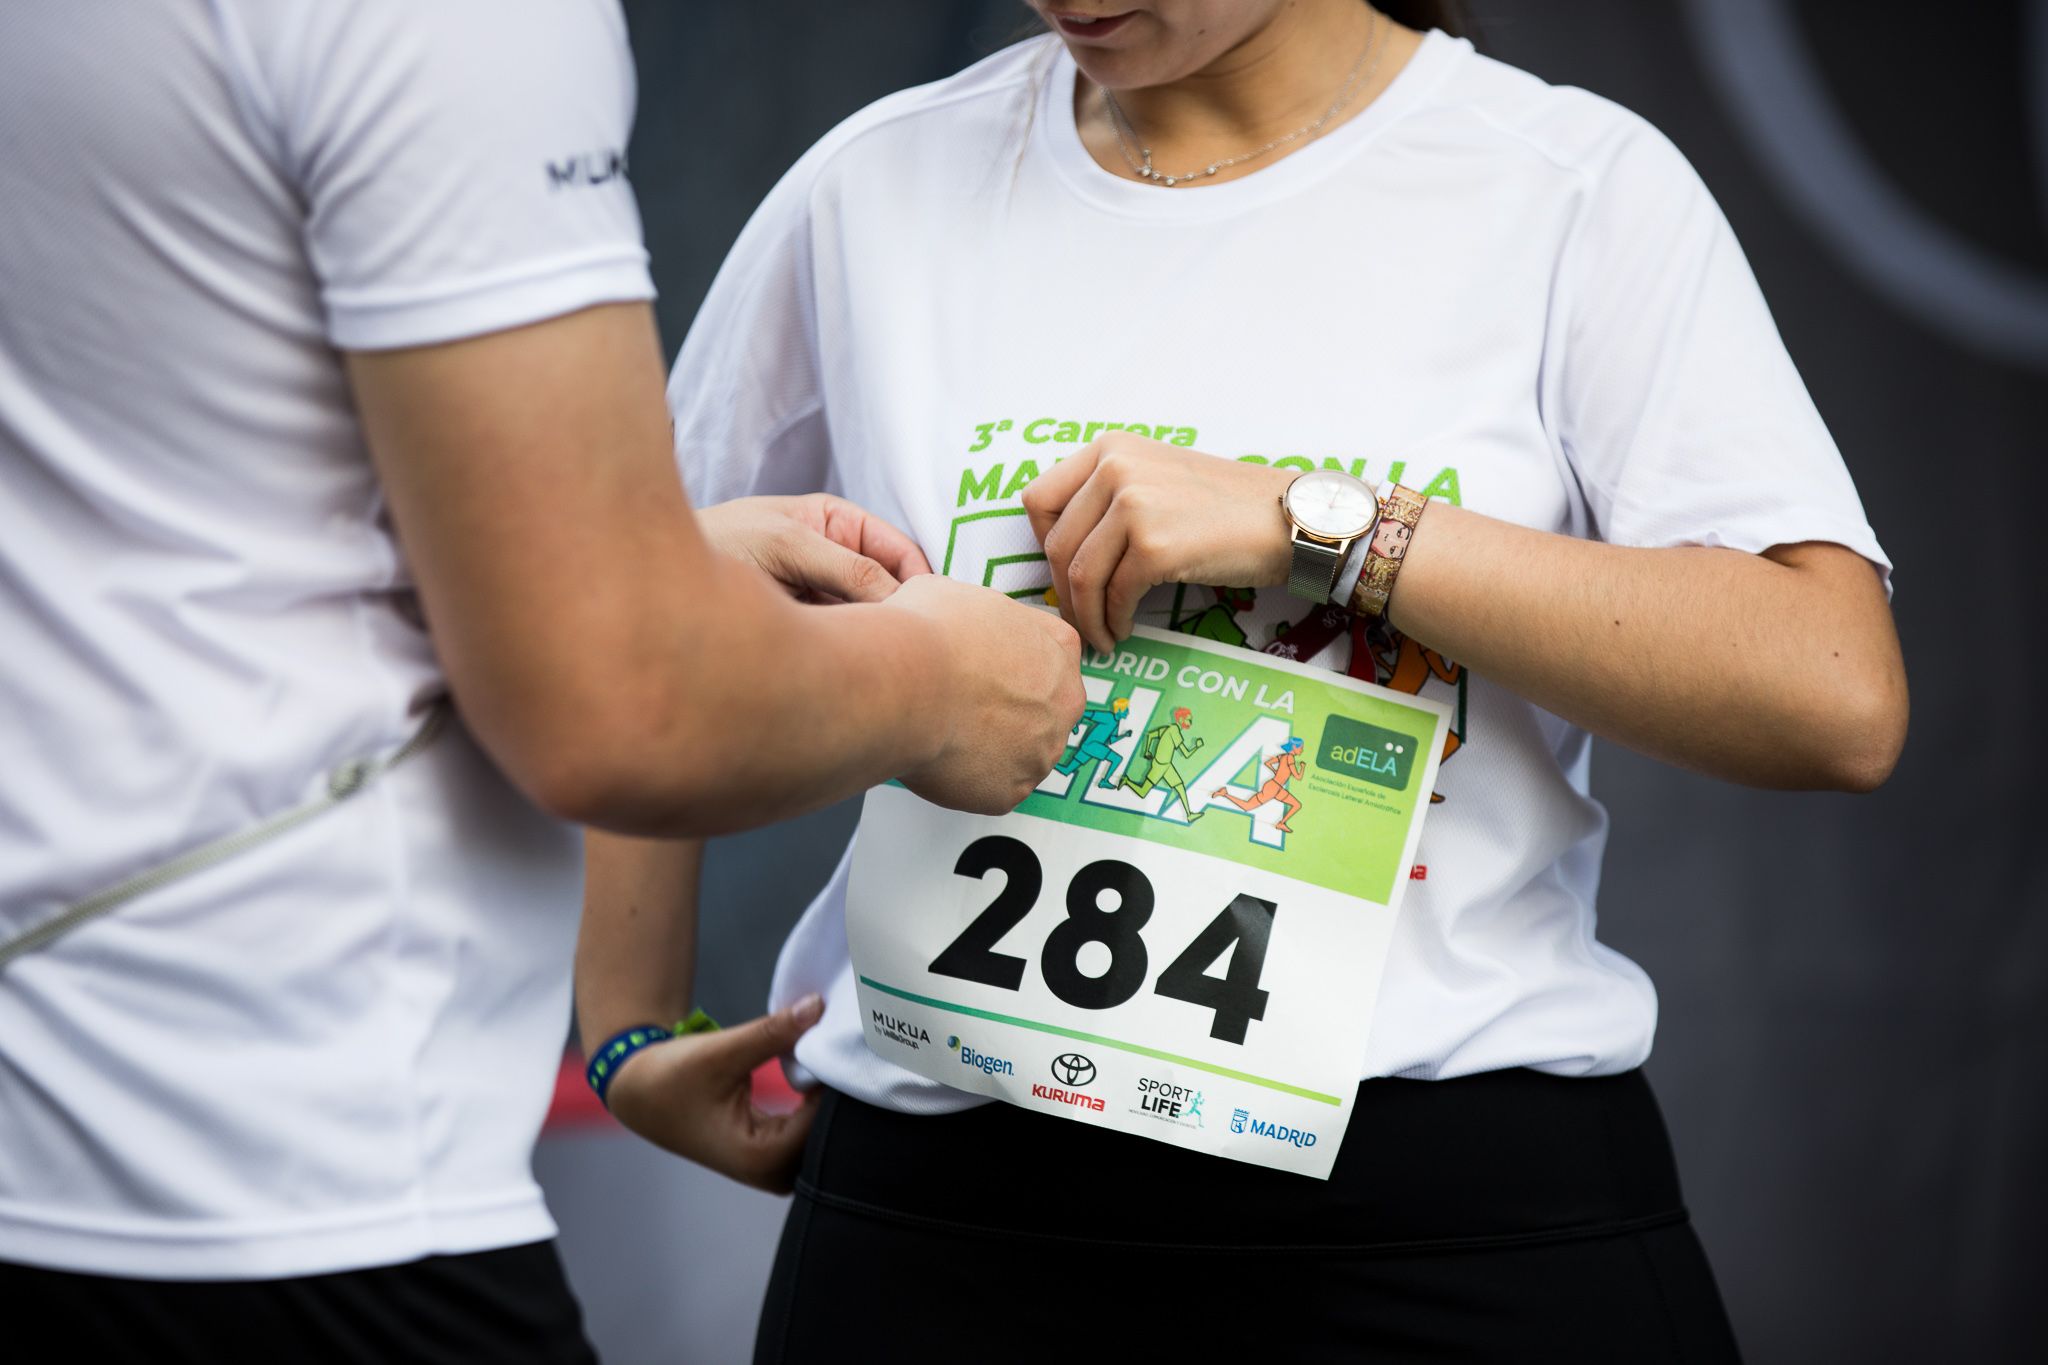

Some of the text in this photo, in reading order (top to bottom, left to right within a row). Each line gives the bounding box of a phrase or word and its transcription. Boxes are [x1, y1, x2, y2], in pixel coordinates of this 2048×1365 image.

[1176, 665, 1250, 701] CON
[1253, 683, 1296, 714] LA
[1329, 743, 1398, 777] adELA
[928, 835, 1278, 1046] 284
[872, 1009, 931, 1044] MUKUA
[1137, 1077, 1194, 1103] SPORT
[1141, 1094, 1182, 1119] LIFE
[1249, 1119, 1317, 1149] MADRID
